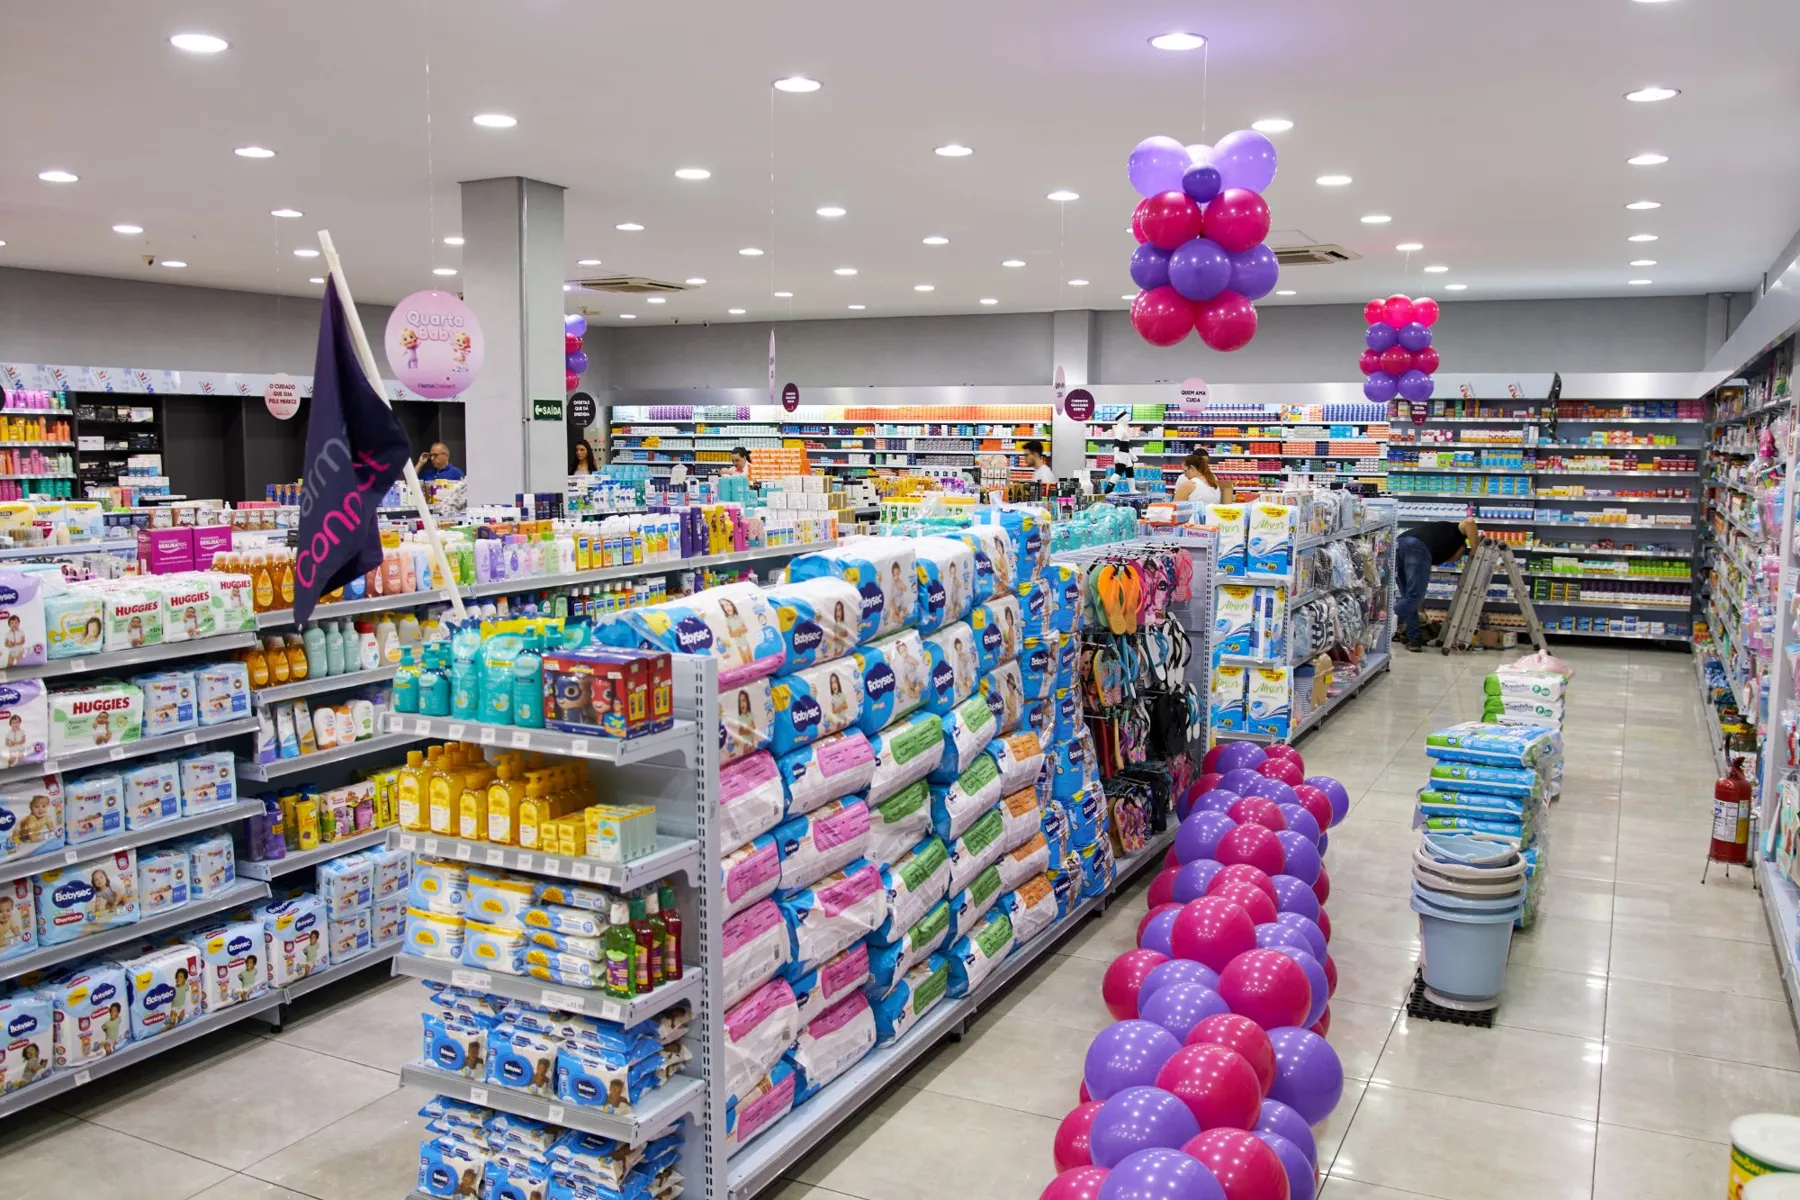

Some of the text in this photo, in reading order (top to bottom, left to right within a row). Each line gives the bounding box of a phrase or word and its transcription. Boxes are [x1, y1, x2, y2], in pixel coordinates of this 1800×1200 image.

[406, 310, 464, 328] Quarta
[419, 327, 455, 342] Baby
[543, 405, 562, 416] SAÍDA
[220, 580, 251, 590] HUGGIES
[170, 591, 210, 607] HUGGIES
[115, 602, 158, 616] HUGGIES
[794, 630, 822, 645] Babysec
[867, 673, 894, 692] Babysec
[934, 670, 953, 687] Babysec
[73, 697, 130, 715] HUGGIES
[793, 705, 820, 723] Babysec
[55, 888, 91, 902] Babysec
[55, 914, 83, 924] Shortinho
[229, 941, 251, 952] Babysec
[92, 988, 115, 1000] Babysec
[146, 990, 174, 1005] Babysec
[10, 1020, 35, 1032] Babysec
